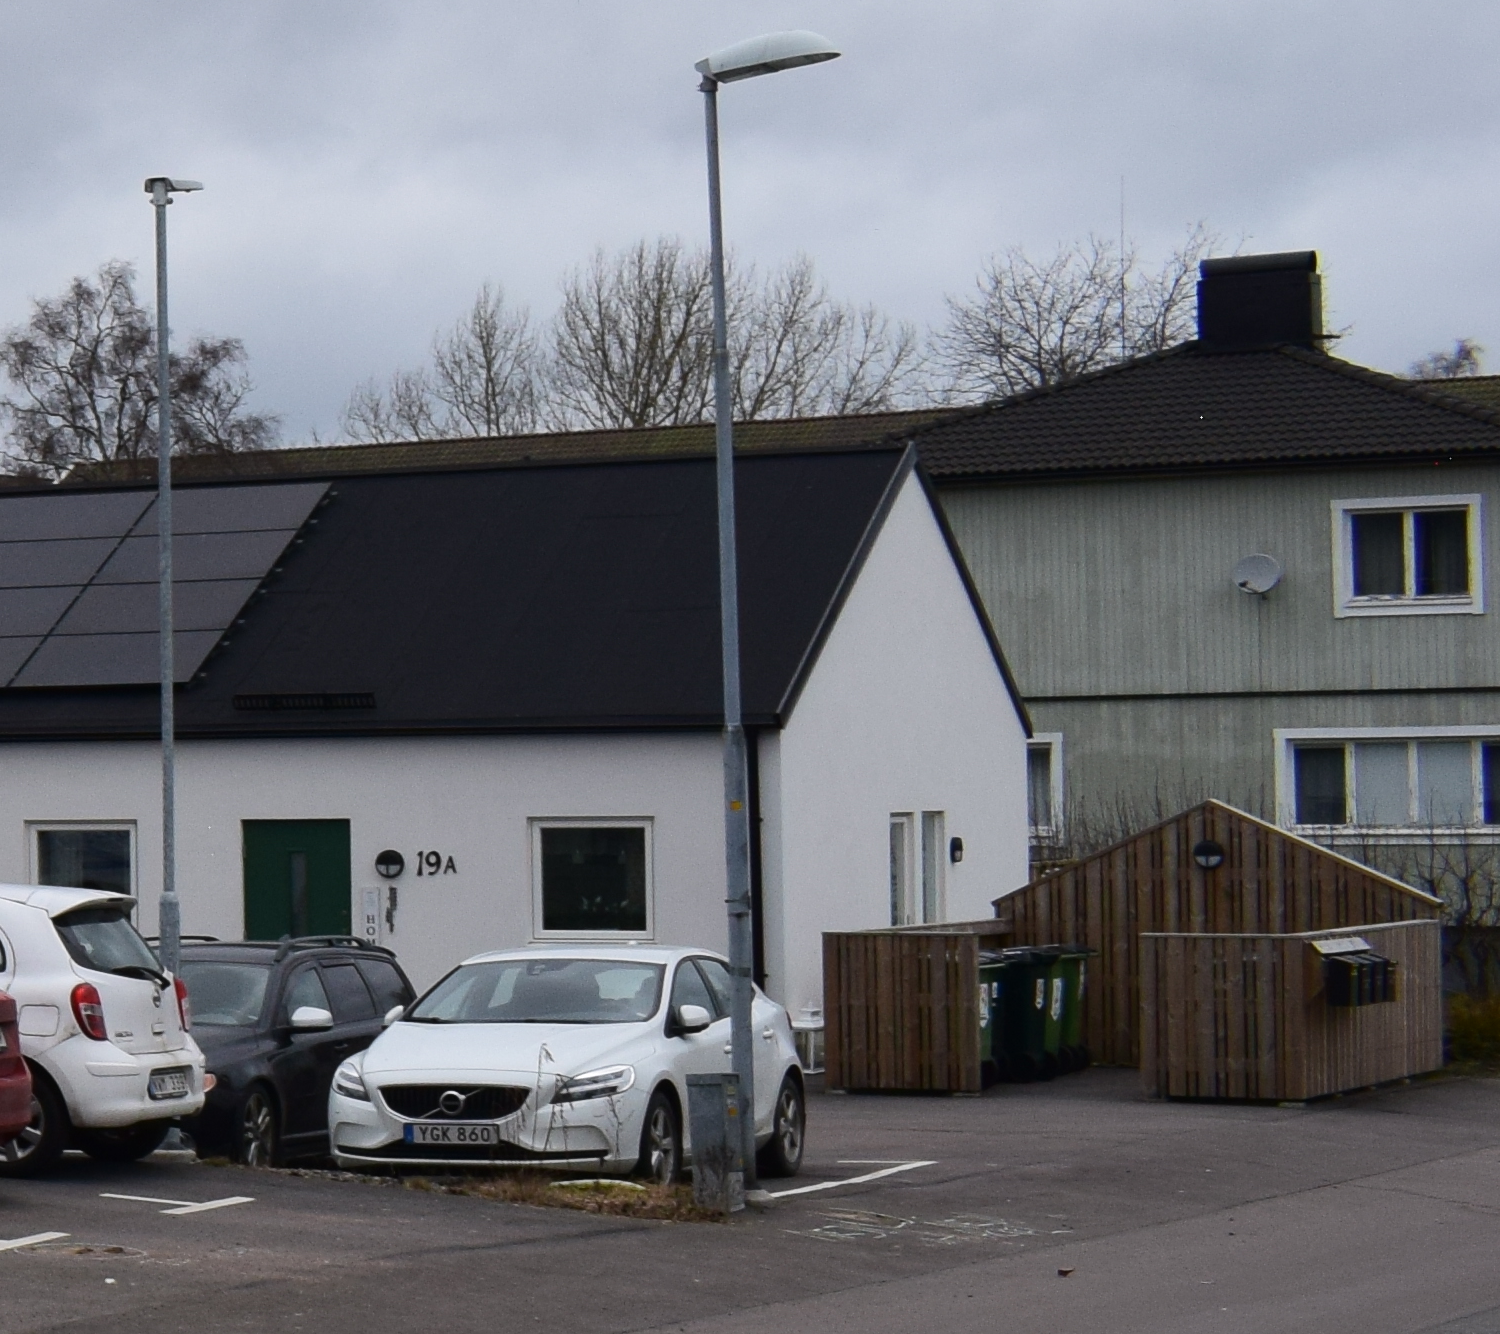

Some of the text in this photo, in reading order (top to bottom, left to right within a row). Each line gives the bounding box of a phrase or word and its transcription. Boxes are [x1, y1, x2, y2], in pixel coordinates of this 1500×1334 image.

[416, 850, 457, 876] 19A
[418, 1126, 490, 1142] YGK 860
